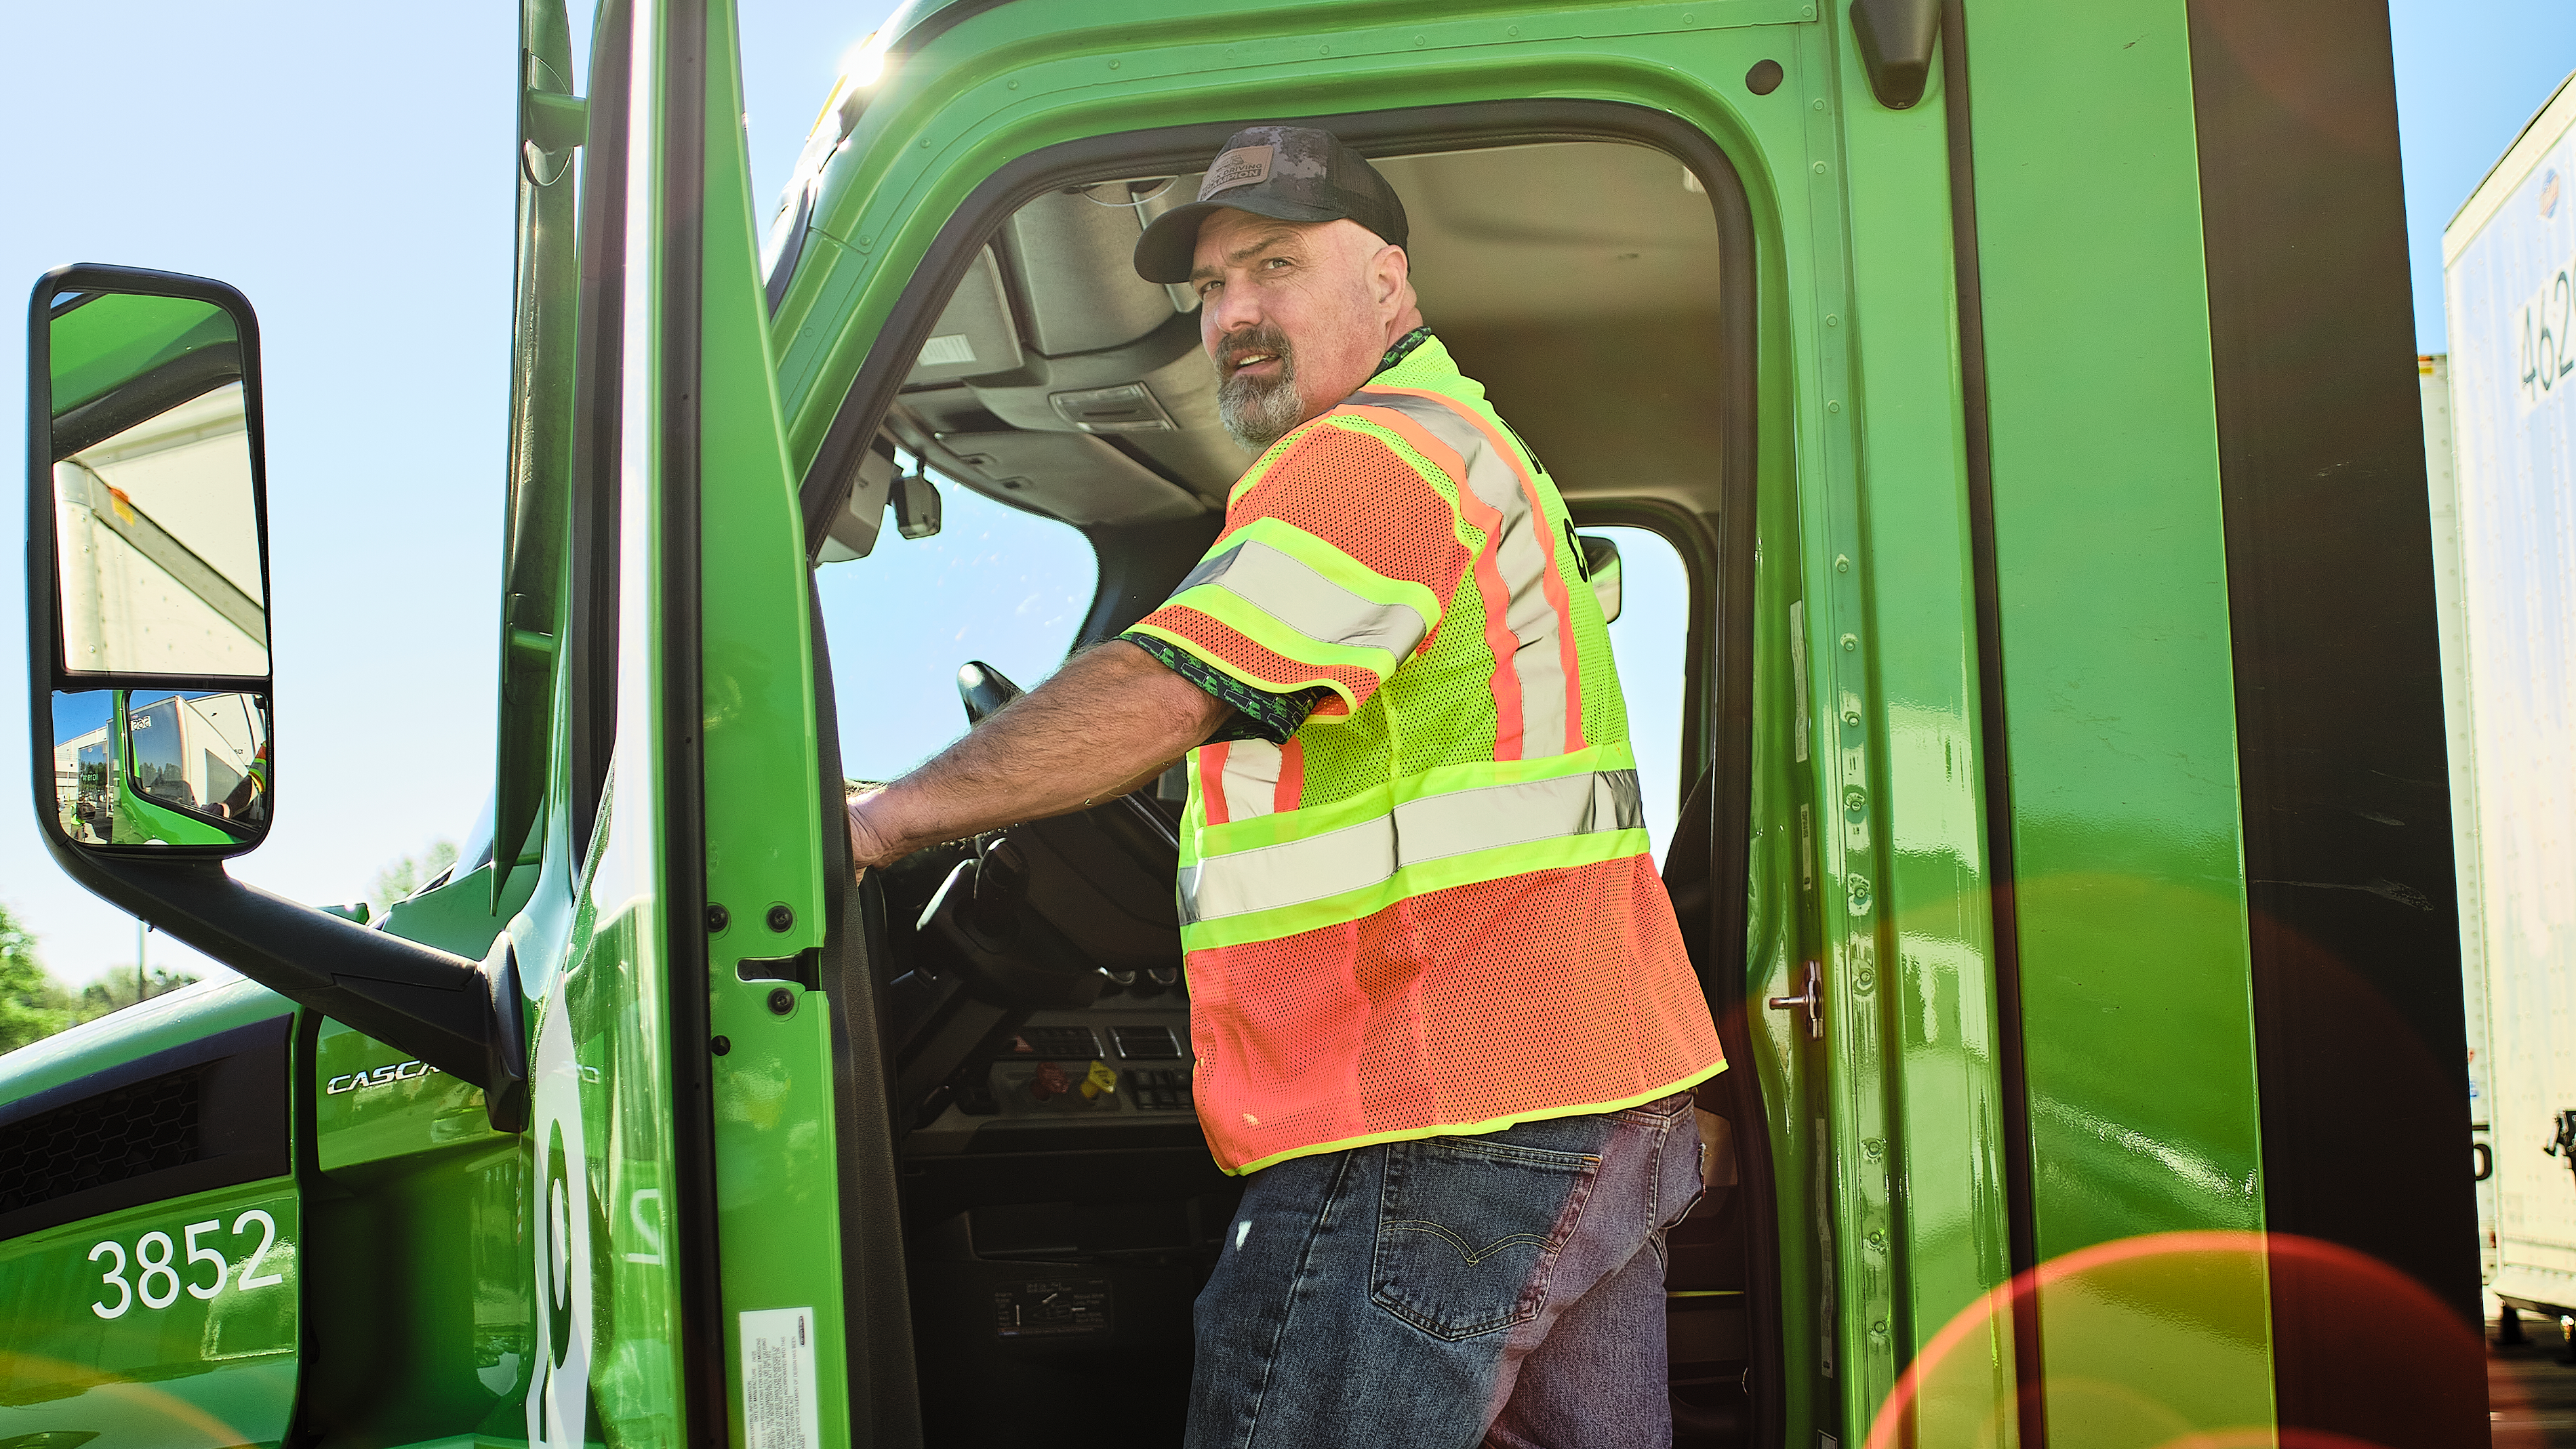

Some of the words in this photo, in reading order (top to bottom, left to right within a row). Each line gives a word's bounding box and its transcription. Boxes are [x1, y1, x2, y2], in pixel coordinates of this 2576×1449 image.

[1223, 163, 1262, 176] DRIVING
[2522, 258, 2576, 402] 462
[87, 1209, 283, 1319] 3852
